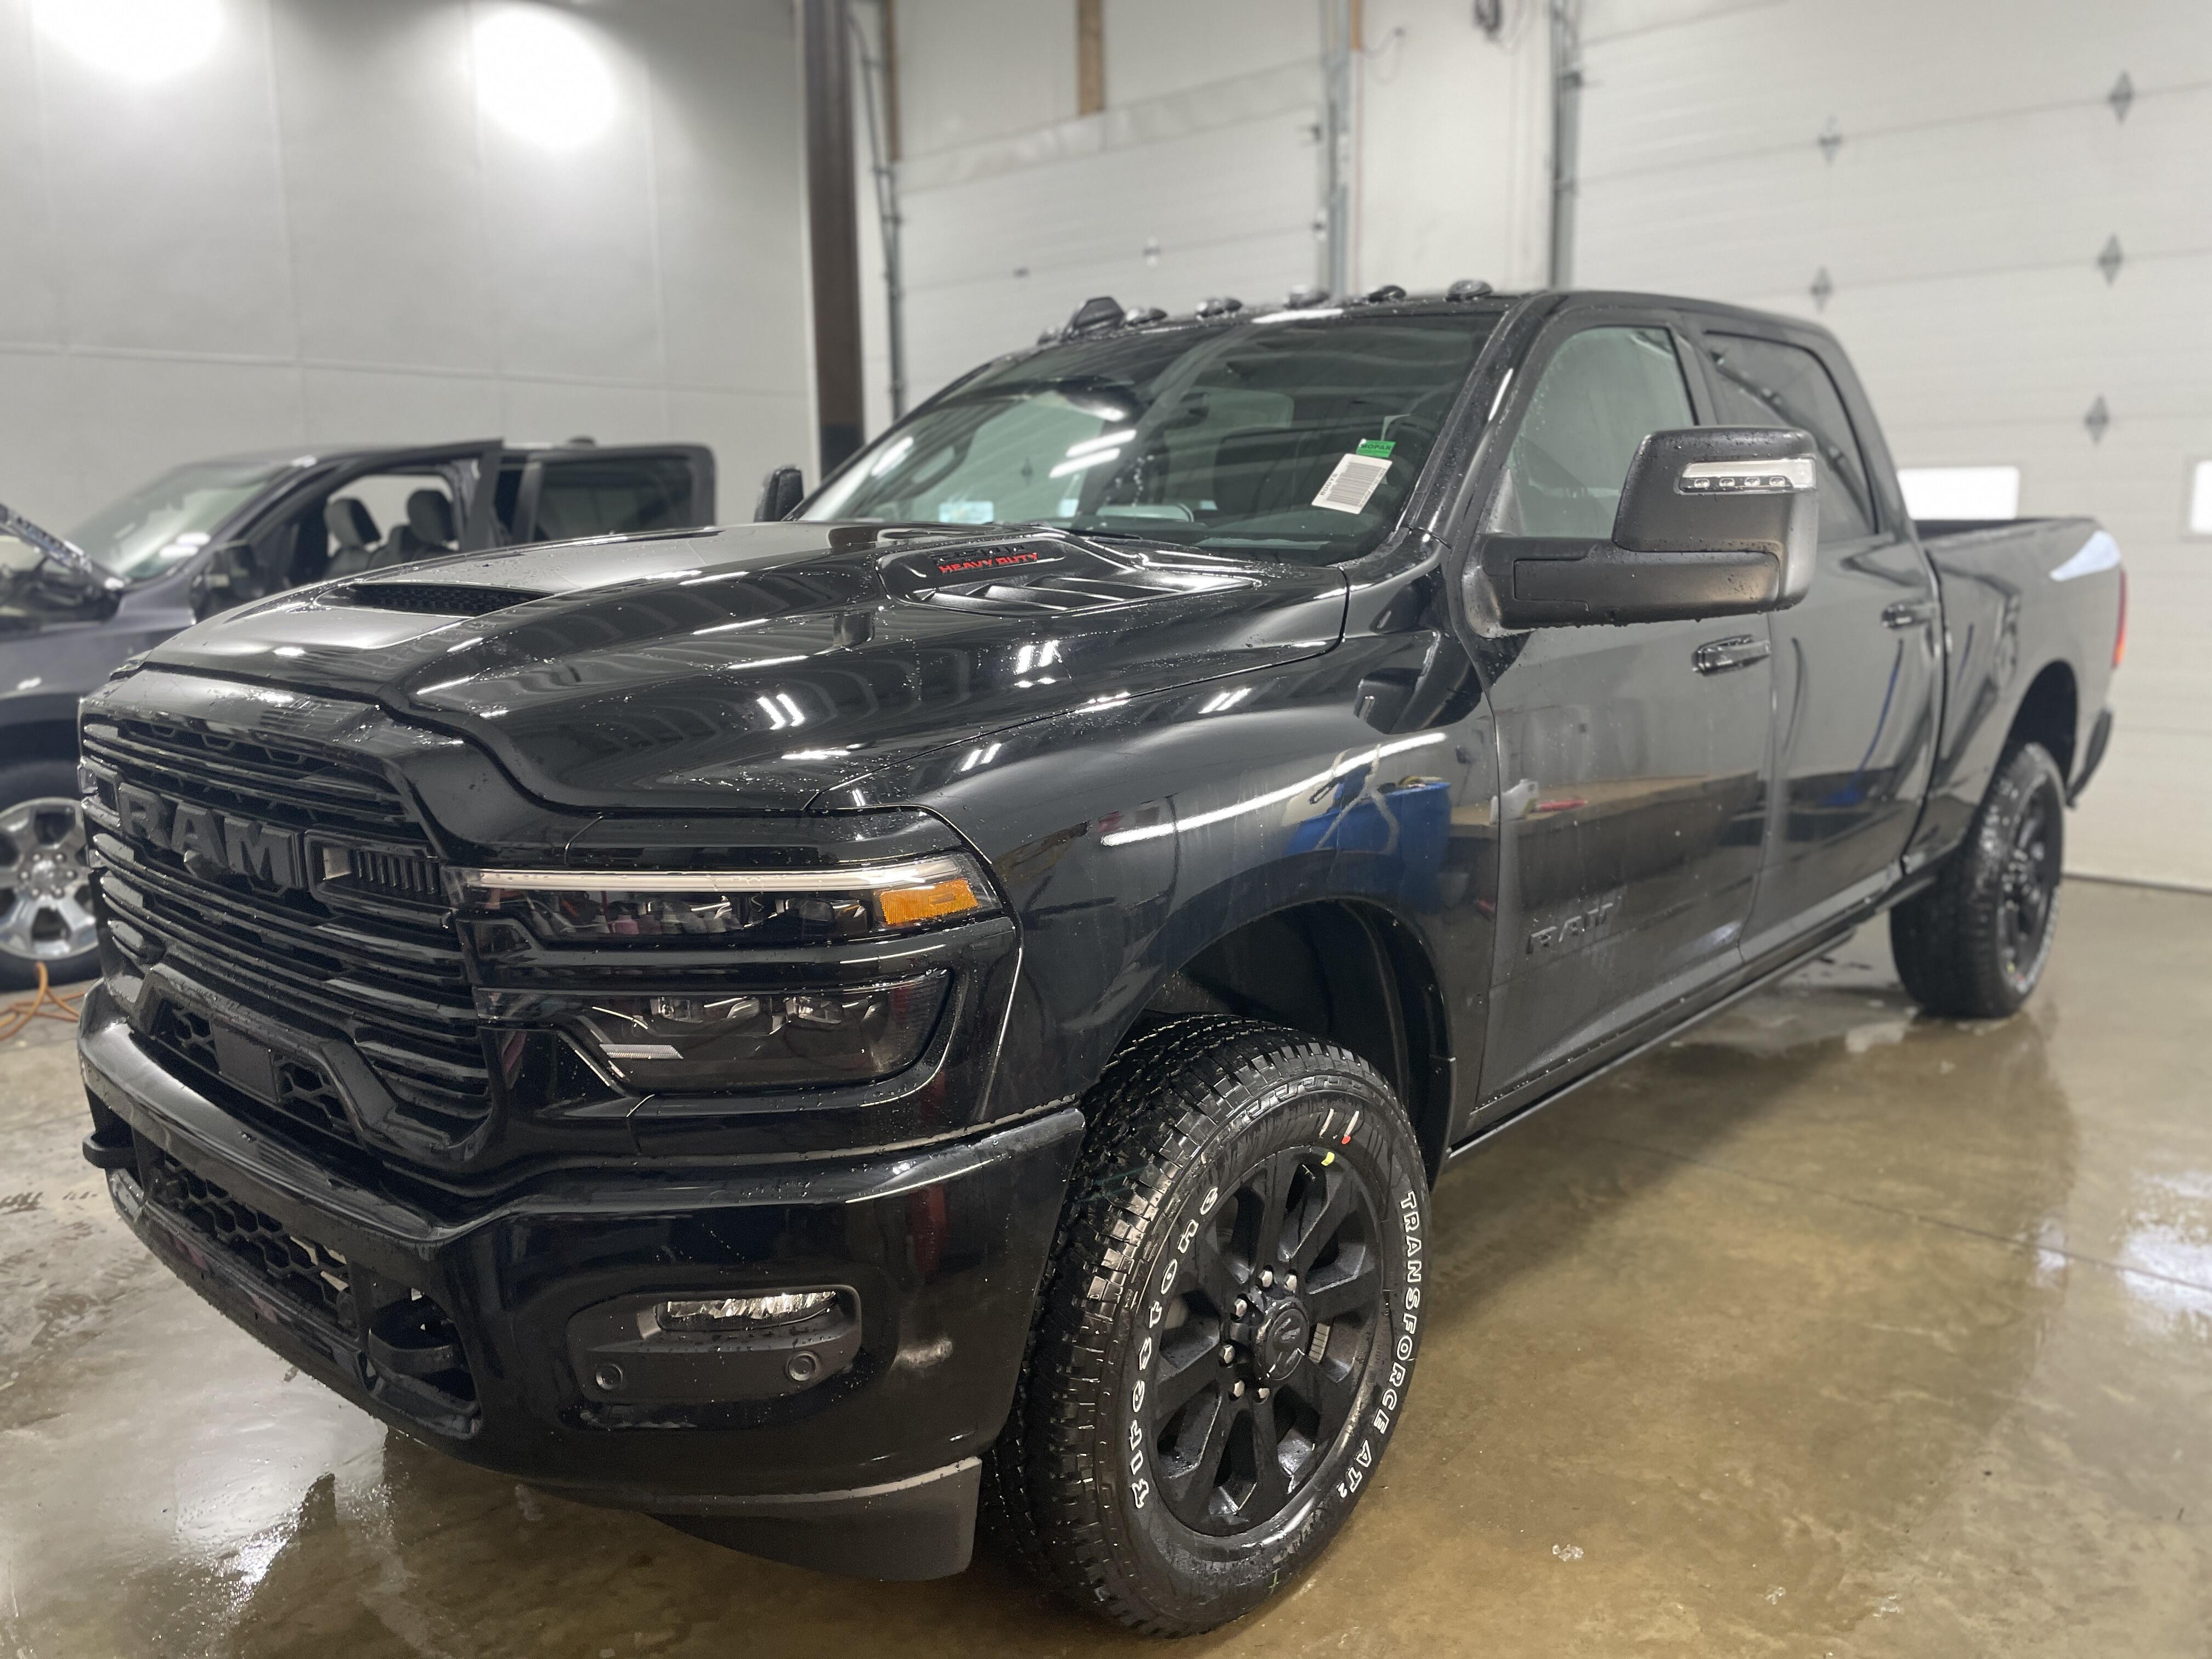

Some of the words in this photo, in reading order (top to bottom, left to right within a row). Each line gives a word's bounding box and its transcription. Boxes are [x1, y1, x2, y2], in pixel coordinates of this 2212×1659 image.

[938, 558, 993, 574] HEAVY
[995, 552, 1039, 566] DUTY
[118, 782, 296, 889] RAM
[1374, 1190, 1423, 1435] TRANSFORCE
